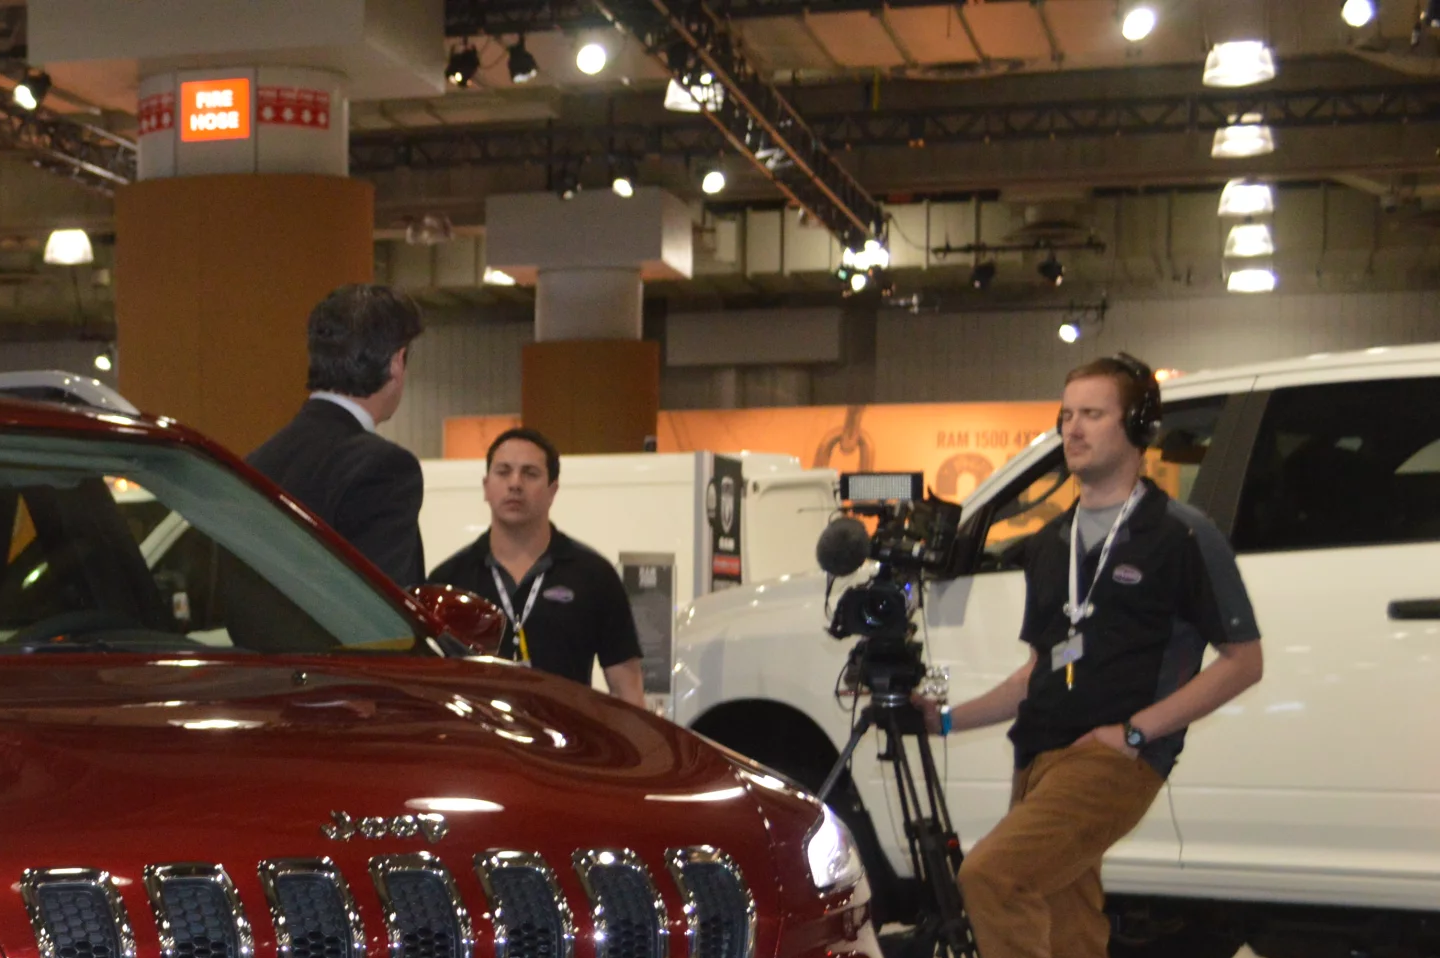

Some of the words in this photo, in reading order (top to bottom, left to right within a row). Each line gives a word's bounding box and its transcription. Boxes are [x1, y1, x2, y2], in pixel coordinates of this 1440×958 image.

[195, 89, 233, 109] FIRE
[190, 111, 239, 131] HOSE
[937, 429, 969, 449] RAM
[975, 429, 1008, 449] 1500
[320, 809, 450, 845] Jeep
